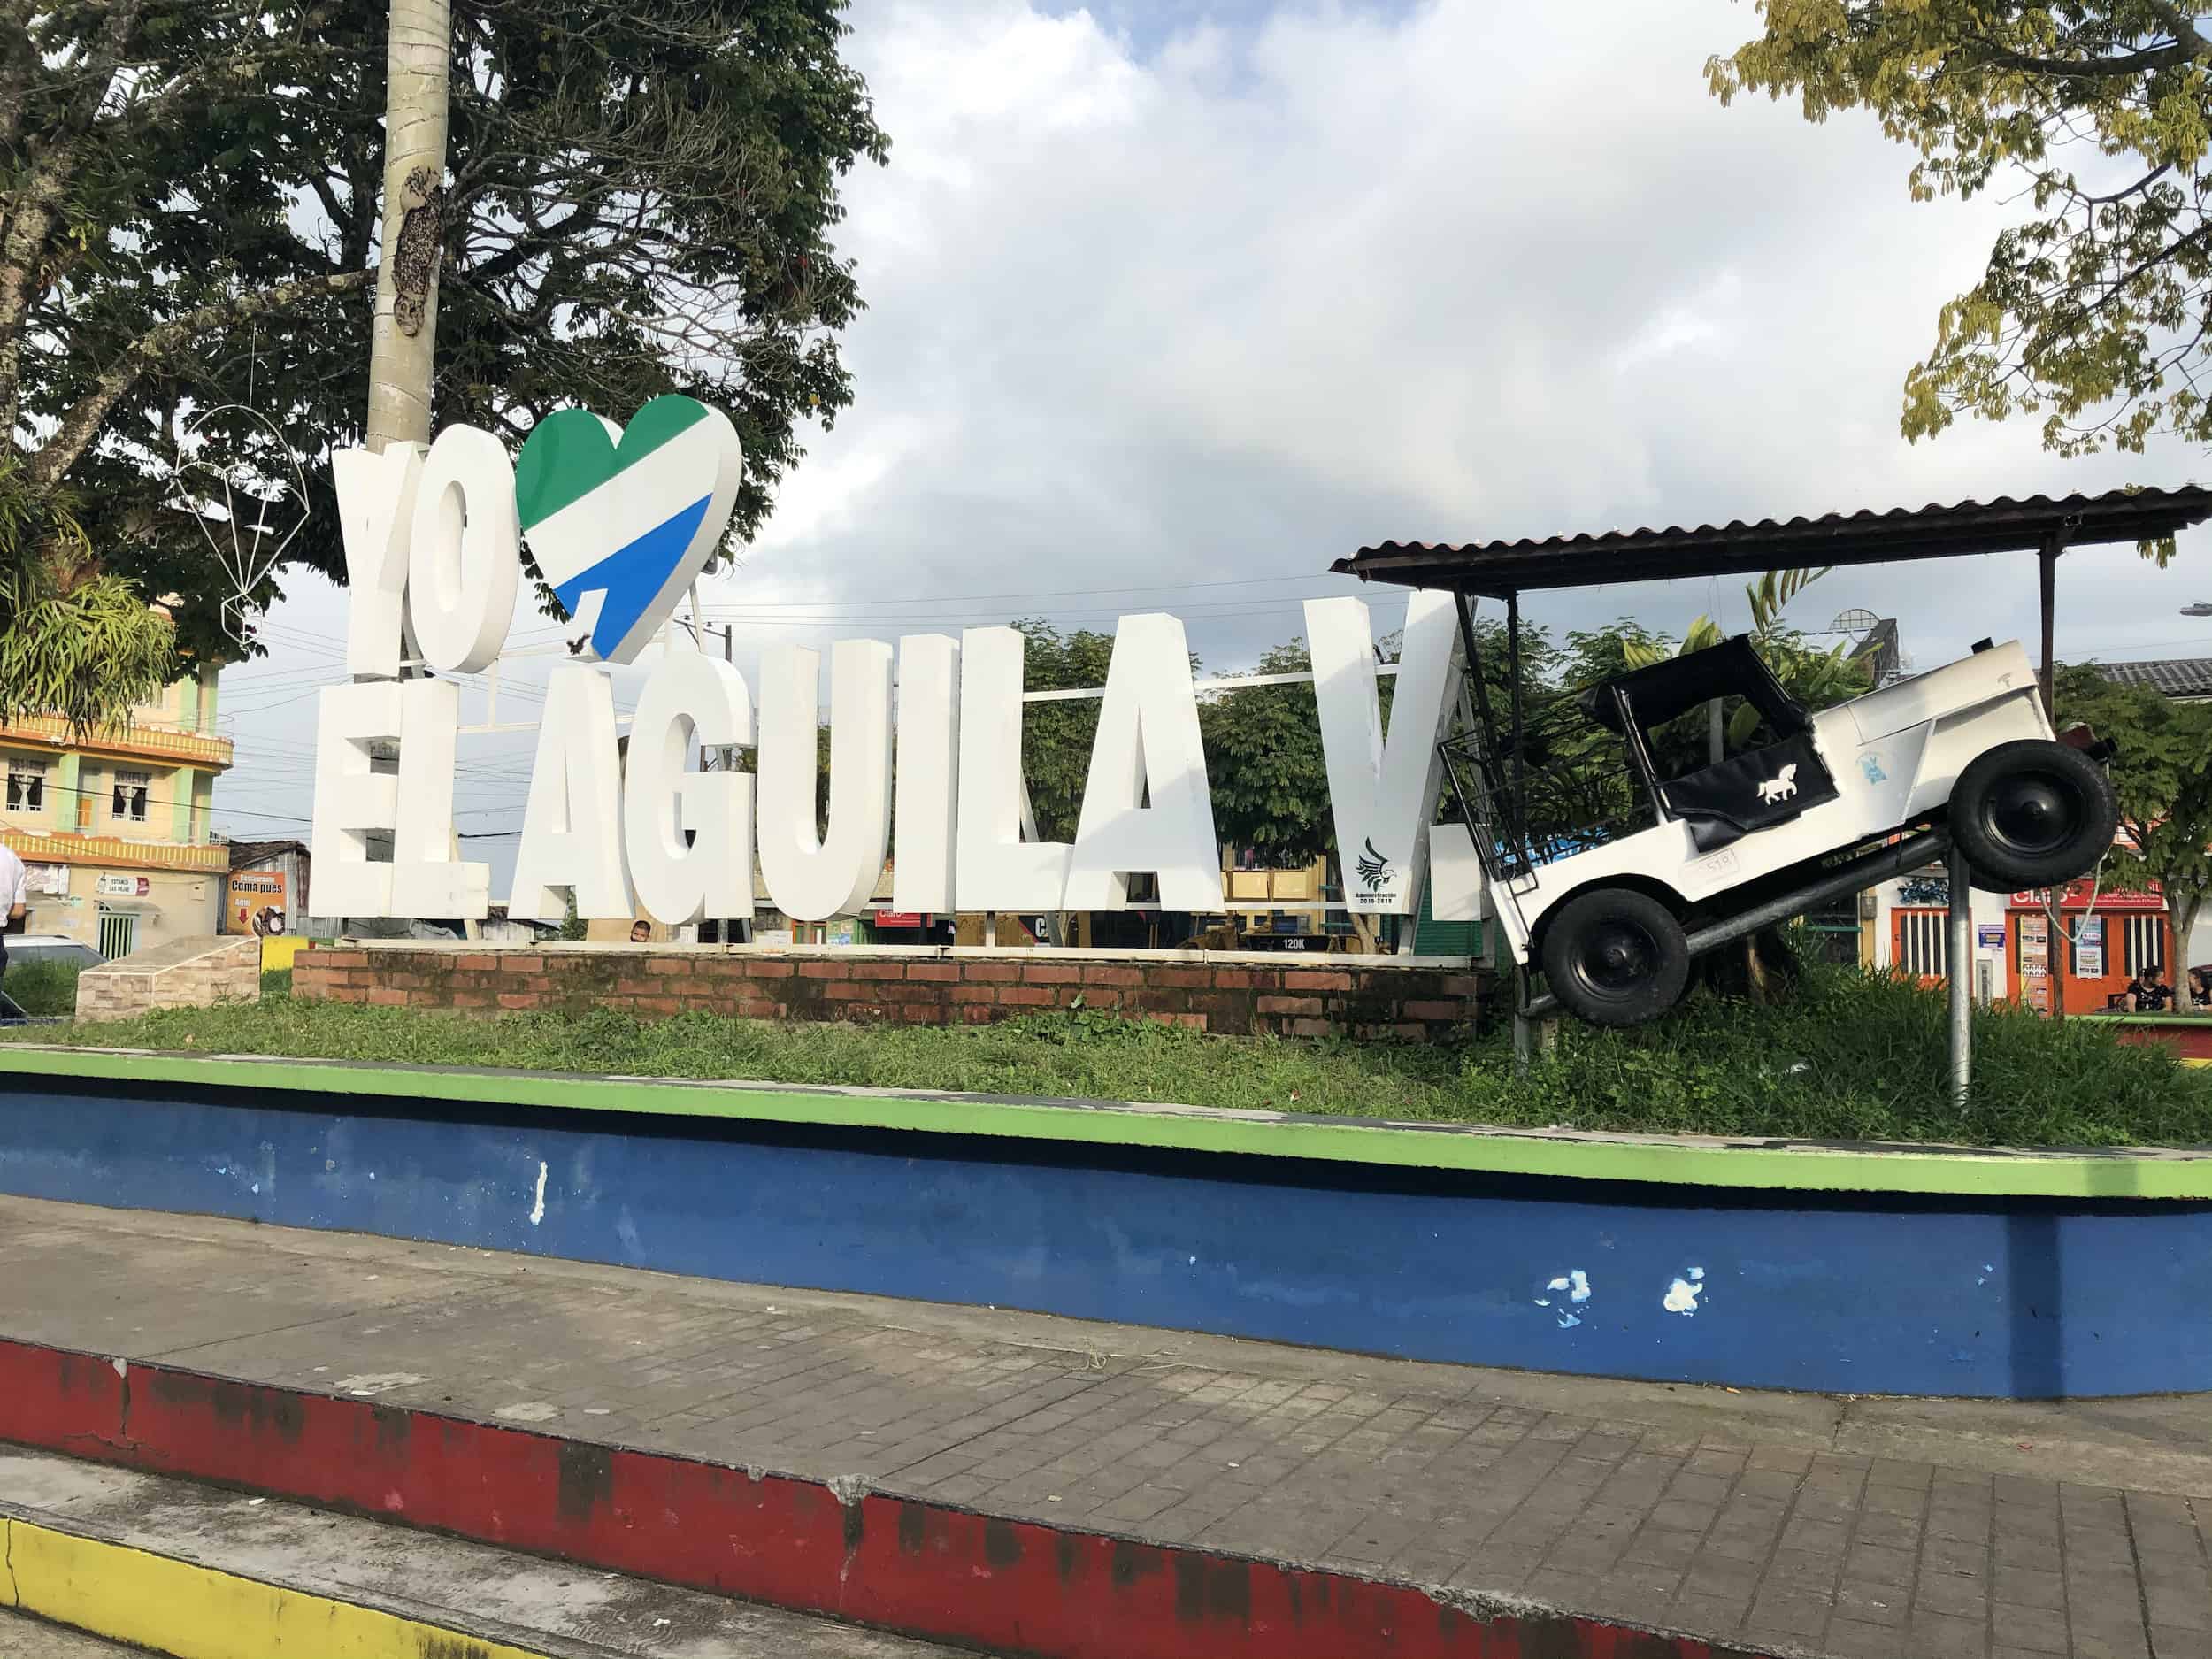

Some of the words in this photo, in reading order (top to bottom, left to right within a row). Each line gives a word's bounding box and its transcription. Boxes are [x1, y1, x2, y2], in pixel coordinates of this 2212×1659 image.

[333, 423, 519, 677] YO
[309, 679, 490, 919] EL
[232, 879, 257, 893] Coma
[260, 883, 282, 895] pues
[1283, 938, 1305, 949] 120K
